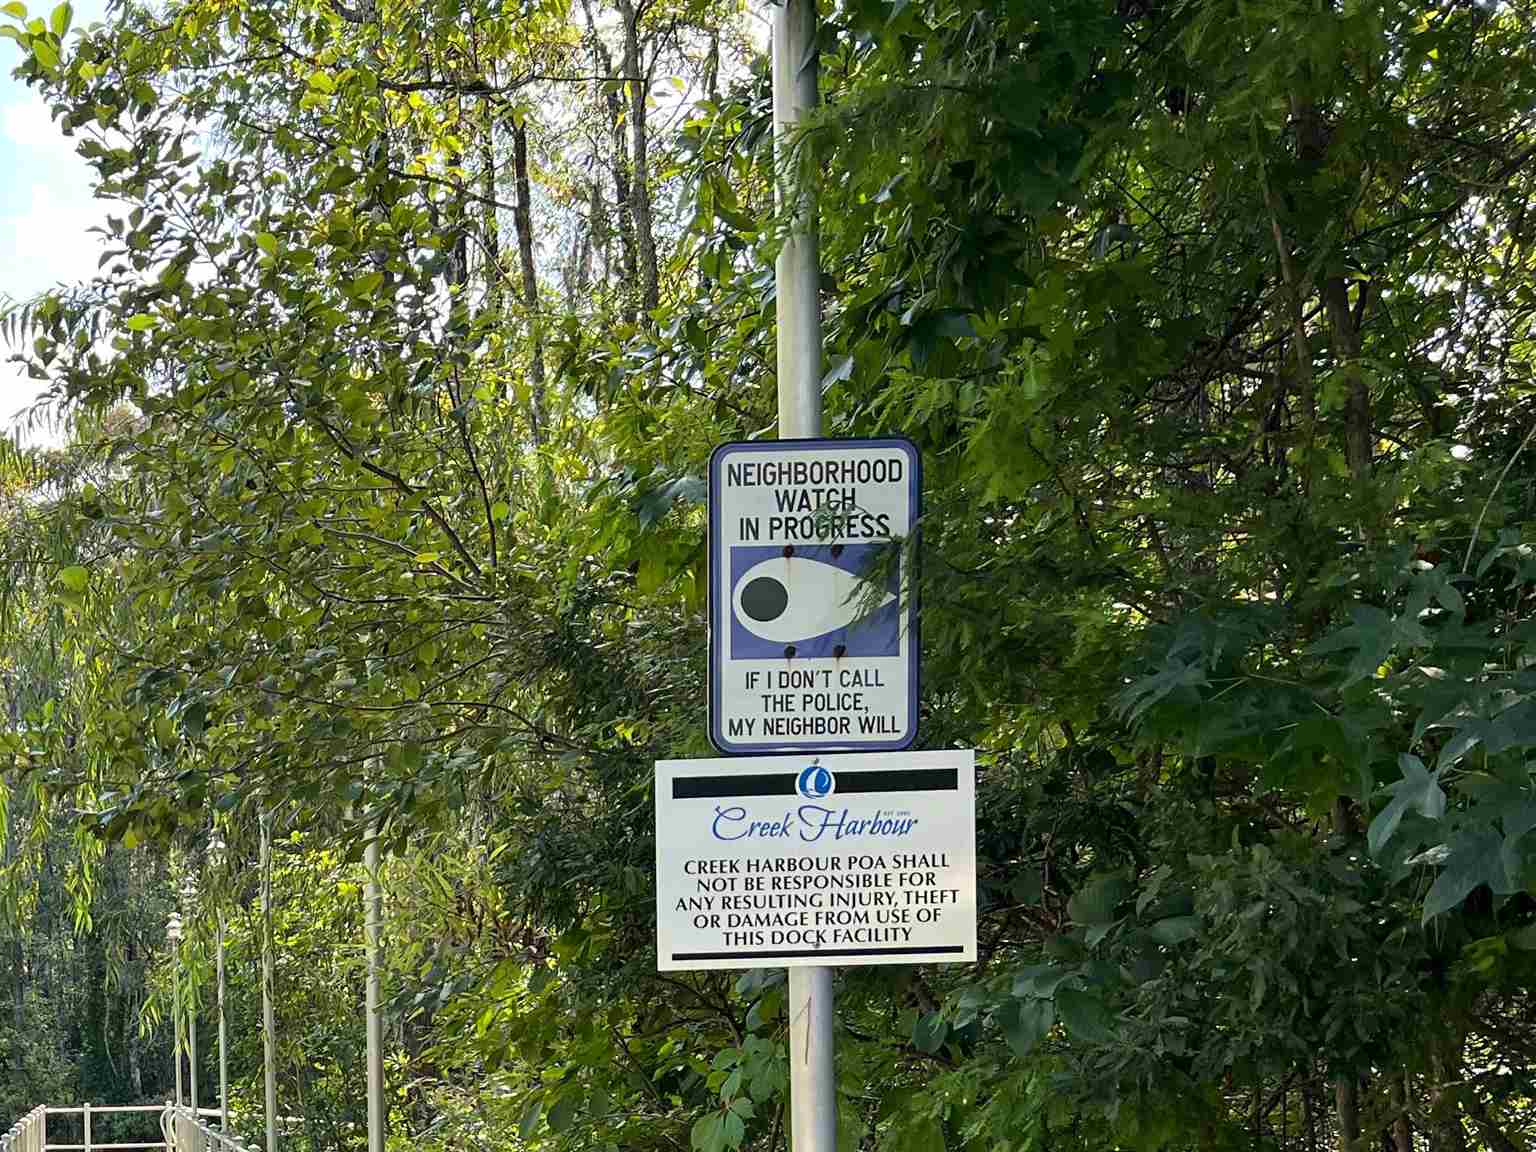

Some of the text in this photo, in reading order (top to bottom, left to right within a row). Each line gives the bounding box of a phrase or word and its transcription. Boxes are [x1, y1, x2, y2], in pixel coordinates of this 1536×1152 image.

[728, 459, 903, 487] NEIGHBORHOOD
[775, 488, 856, 513] WATCH
[740, 517, 760, 541] IN
[745, 669, 884, 689] IF I DON'T CALL
[762, 693, 869, 713] THE POLICE,
[729, 716, 900, 736] MY NEIGHBOR WILL
[712, 805, 918, 842] Creek Harbour
[684, 853, 950, 875] CREEK HARBOUR POA SHALL
[697, 872, 936, 893] NOT BE RESPONSIBLE FOR
[675, 889, 960, 912] ANY RESULTING INJURY, THEFT
[693, 907, 942, 929] OR DAMAGE FROM USE OF
[722, 927, 913, 947] THIS DOCK FACILITY
